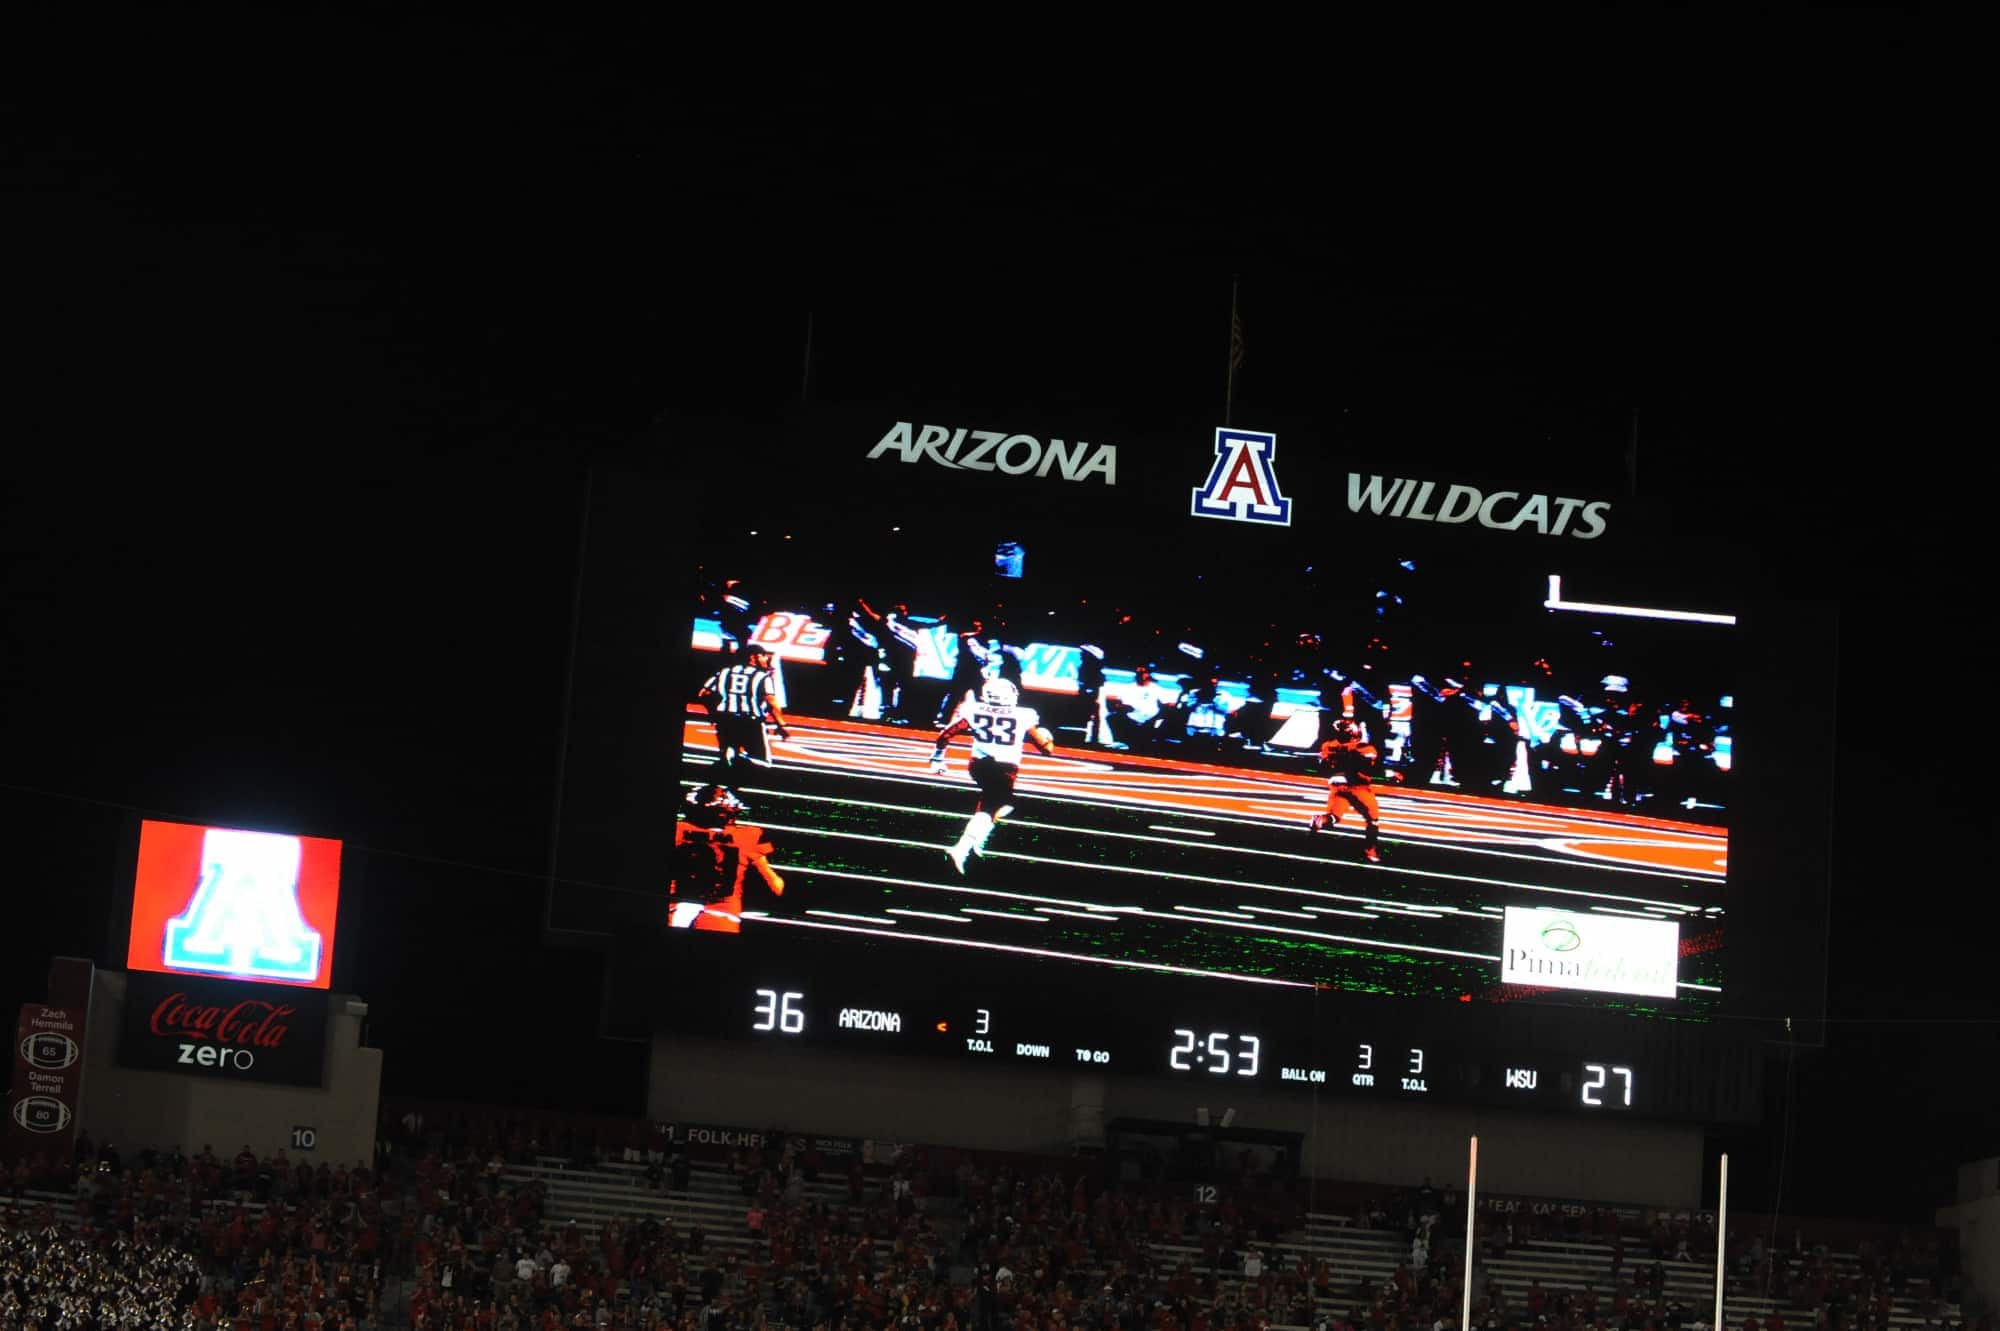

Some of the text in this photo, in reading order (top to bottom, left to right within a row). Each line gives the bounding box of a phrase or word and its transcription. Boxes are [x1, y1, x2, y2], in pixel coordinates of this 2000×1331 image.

[867, 421, 1117, 486] ARIZONA
[1191, 426, 1292, 527] A
[1347, 472, 1611, 540] WILDCATS
[974, 714, 1016, 745] 33
[40, 1008, 67, 1020] Zach
[753, 988, 804, 1033] 36
[838, 1008, 901, 1033] ARIZONA
[975, 1009, 990, 1034] 3
[42, 1046, 57, 1057] 65
[176, 1044, 256, 1071] zero
[1016, 1043, 1050, 1058] DOWN
[1076, 1049, 1110, 1063] TO GO
[1170, 1029, 1260, 1076] 2:53
[1358, 1044, 1373, 1069] 3
[1409, 1049, 1424, 1074] 3
[28, 1071, 65, 1084] Damon
[1281, 1068, 1326, 1083] BALL ON
[1352, 1074, 1375, 1087] QTR
[1505, 1068, 1537, 1089] WSU
[1582, 1065, 1632, 1107] 27
[31, 1081, 62, 1094] Terrell
[292, 1128, 316, 1148] 10
[687, 1128, 732, 1146] FOLK
[1197, 1186, 1217, 1203] 12
